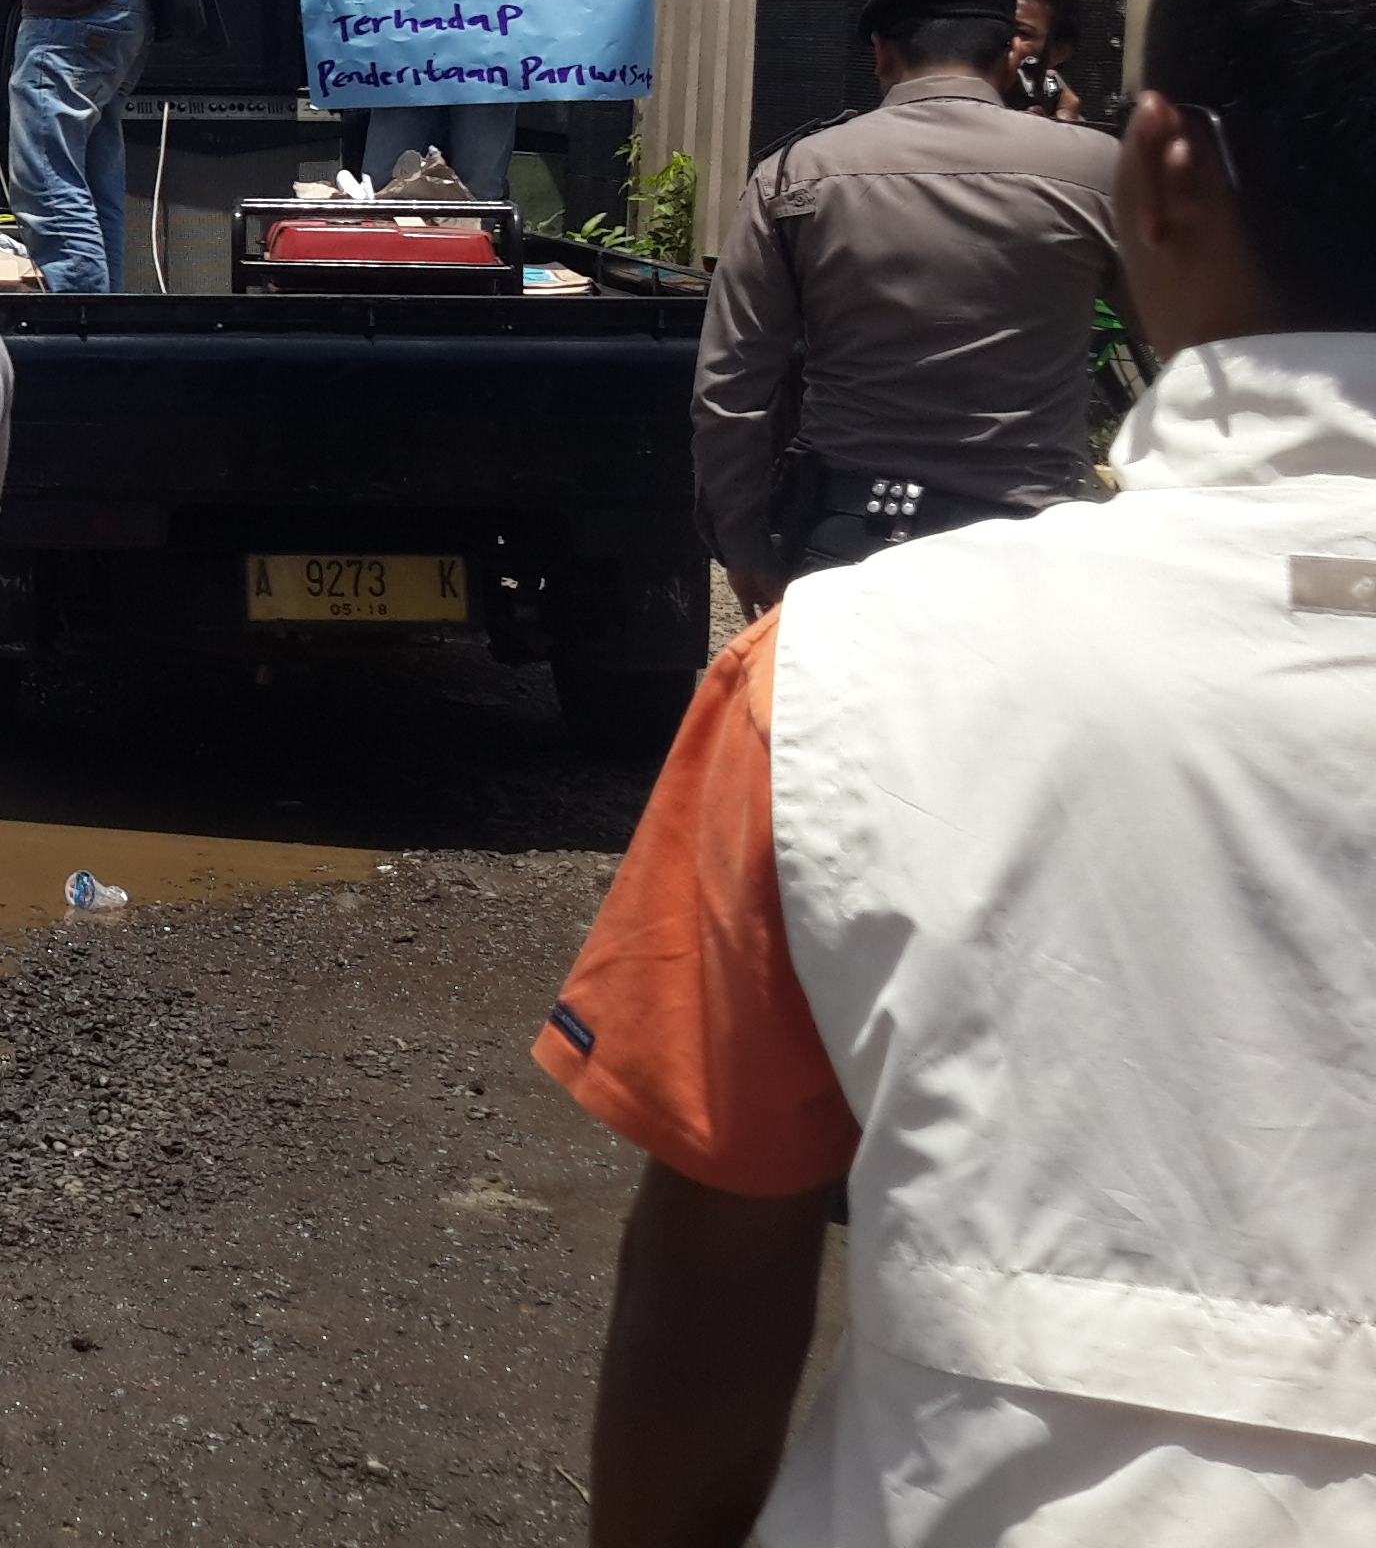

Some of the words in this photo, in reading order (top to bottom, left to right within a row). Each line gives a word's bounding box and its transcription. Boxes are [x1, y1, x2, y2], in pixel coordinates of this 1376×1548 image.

[255, 559, 273, 596] A
[305, 559, 386, 597] 9273
[439, 559, 459, 598] K
